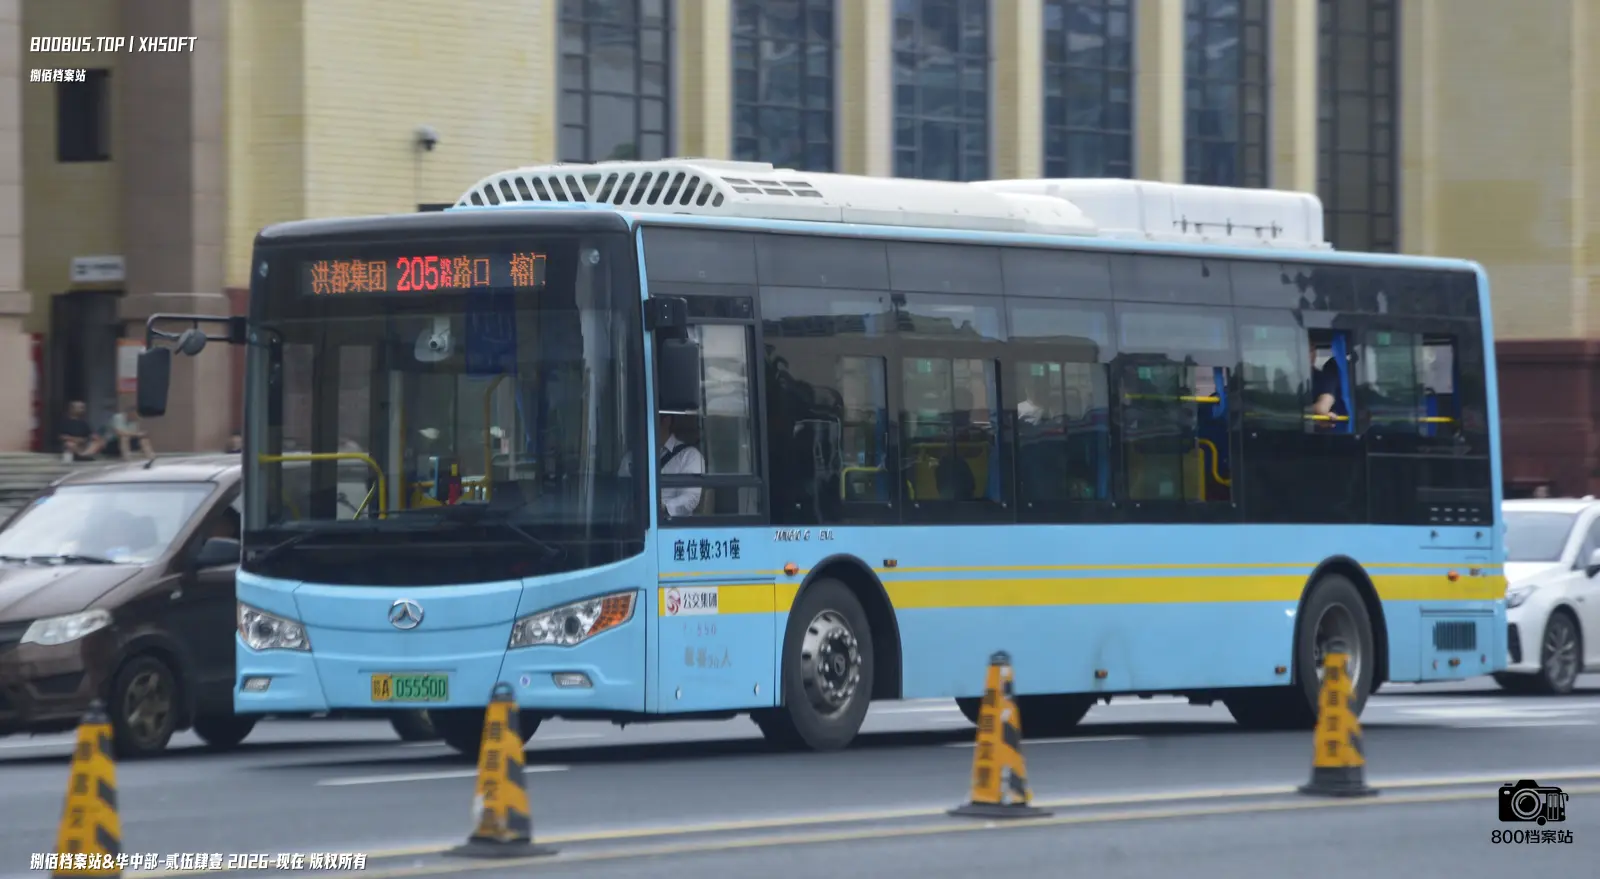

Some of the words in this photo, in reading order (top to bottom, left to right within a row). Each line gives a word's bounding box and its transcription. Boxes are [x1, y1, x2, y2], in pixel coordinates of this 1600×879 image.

[310, 259, 387, 294] 洪都集团
[673, 537, 741, 561] 座位数:31座
